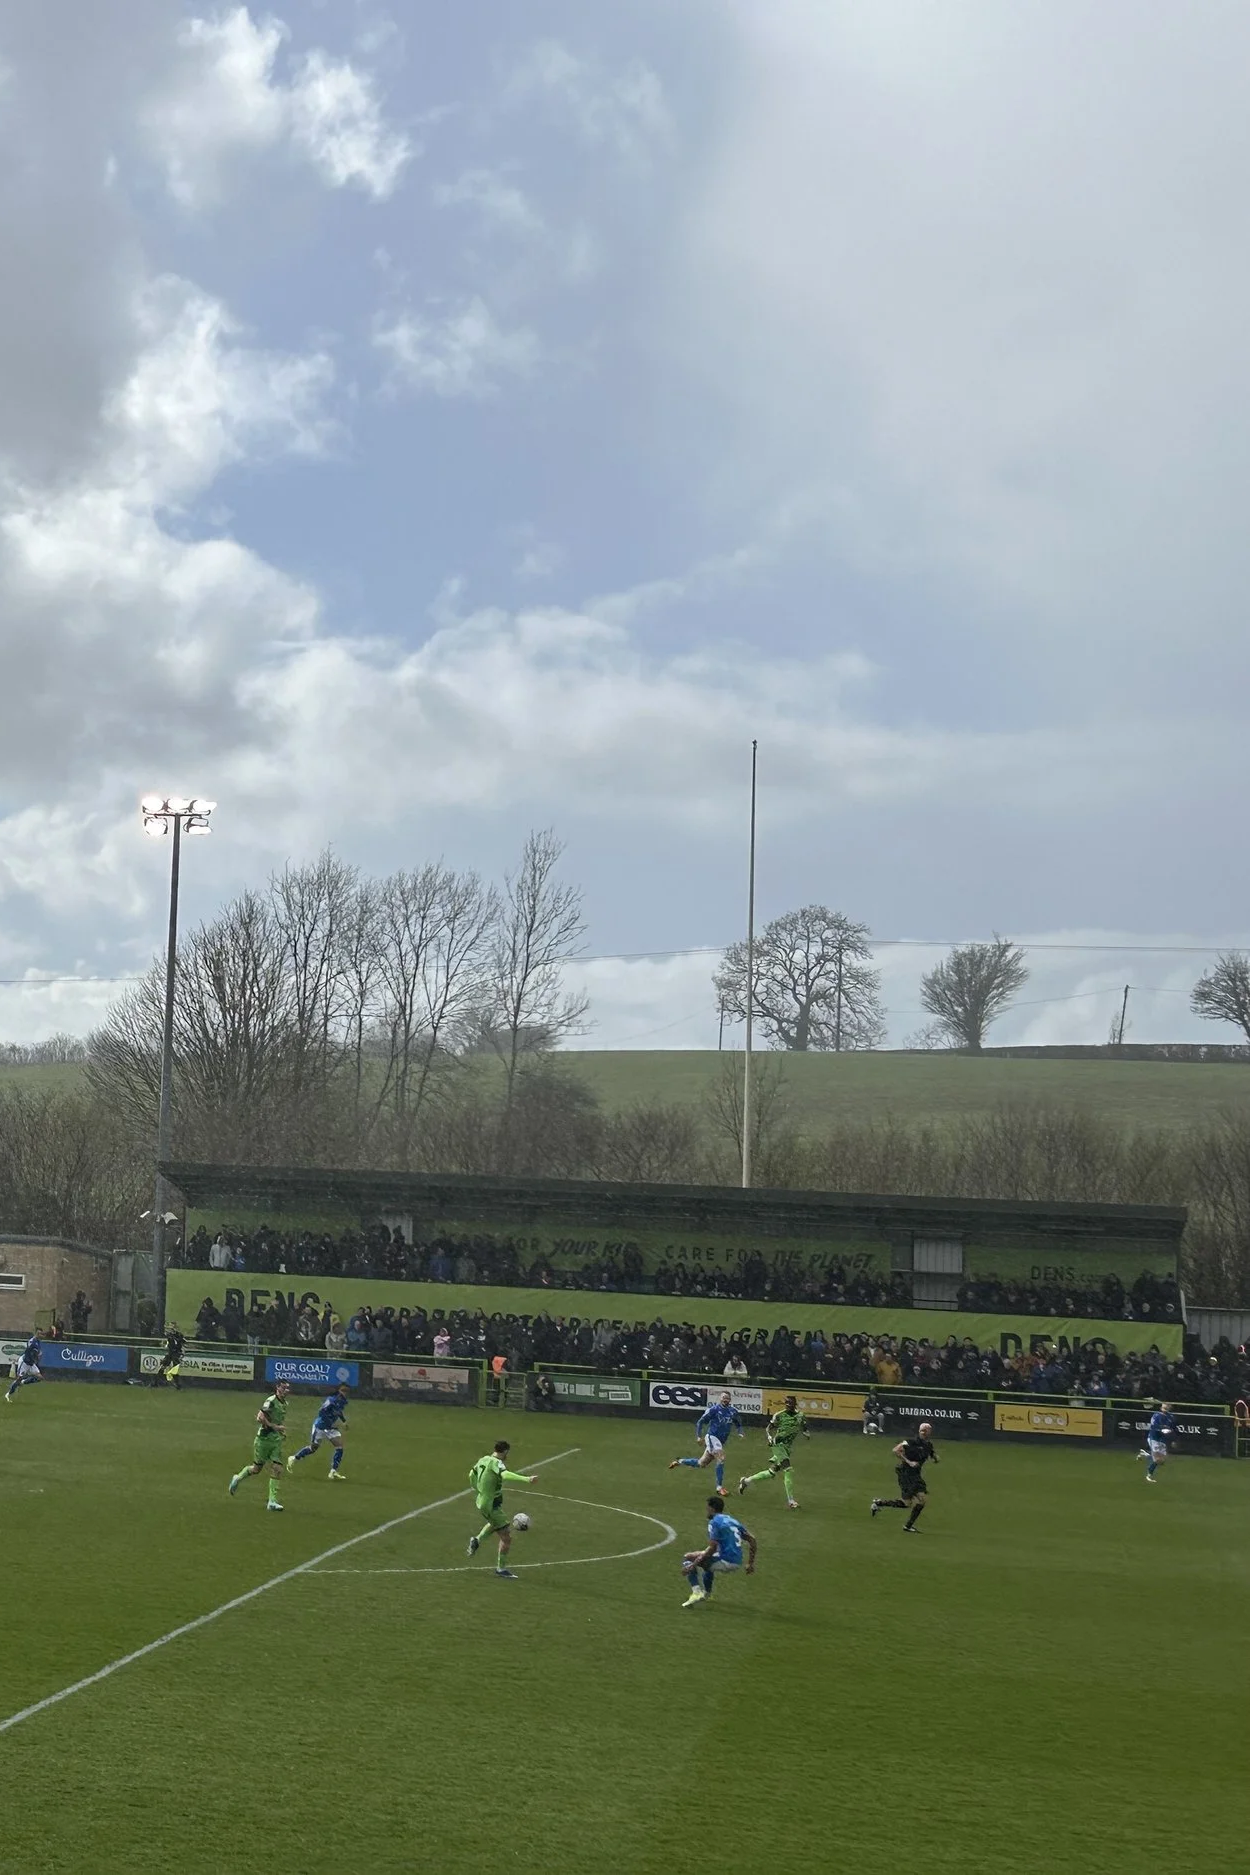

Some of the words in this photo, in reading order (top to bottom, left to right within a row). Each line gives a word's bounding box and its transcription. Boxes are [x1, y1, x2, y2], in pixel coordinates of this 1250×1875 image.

[665, 1244, 715, 1261] CARE
[60, 1347, 106, 1368] Culligan
[275, 1361, 297, 1372] OUR
[298, 1363, 331, 1374] GOAL?
[899, 1407, 962, 1419] UMBRO.CO.UK
